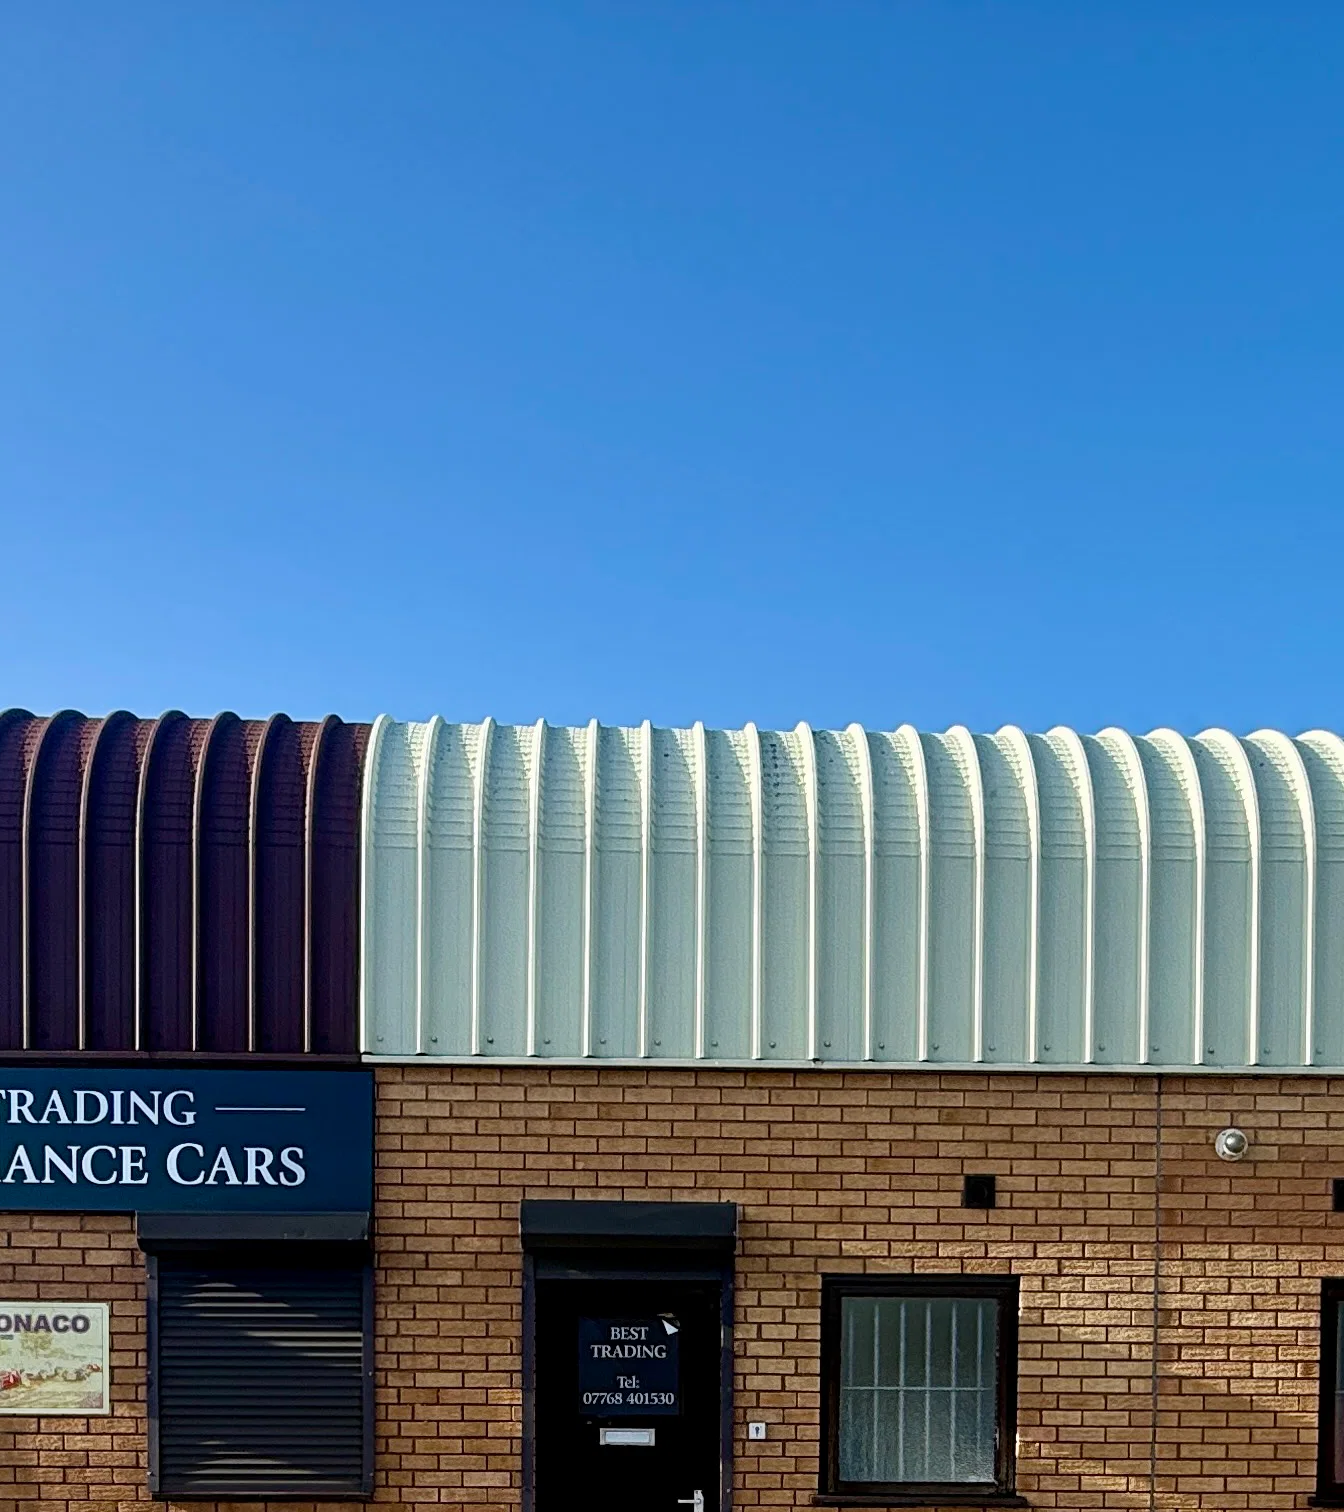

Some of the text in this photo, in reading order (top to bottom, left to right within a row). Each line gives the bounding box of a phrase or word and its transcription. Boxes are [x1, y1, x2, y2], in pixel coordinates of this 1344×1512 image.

[166, 1142, 306, 1187] CARS
[610, 1326, 649, 1341] BEST
[590, 1344, 667, 1359] TRADING
[616, 1375, 640, 1389] Tel:
[582, 1392, 675, 1405] 07768 401530
